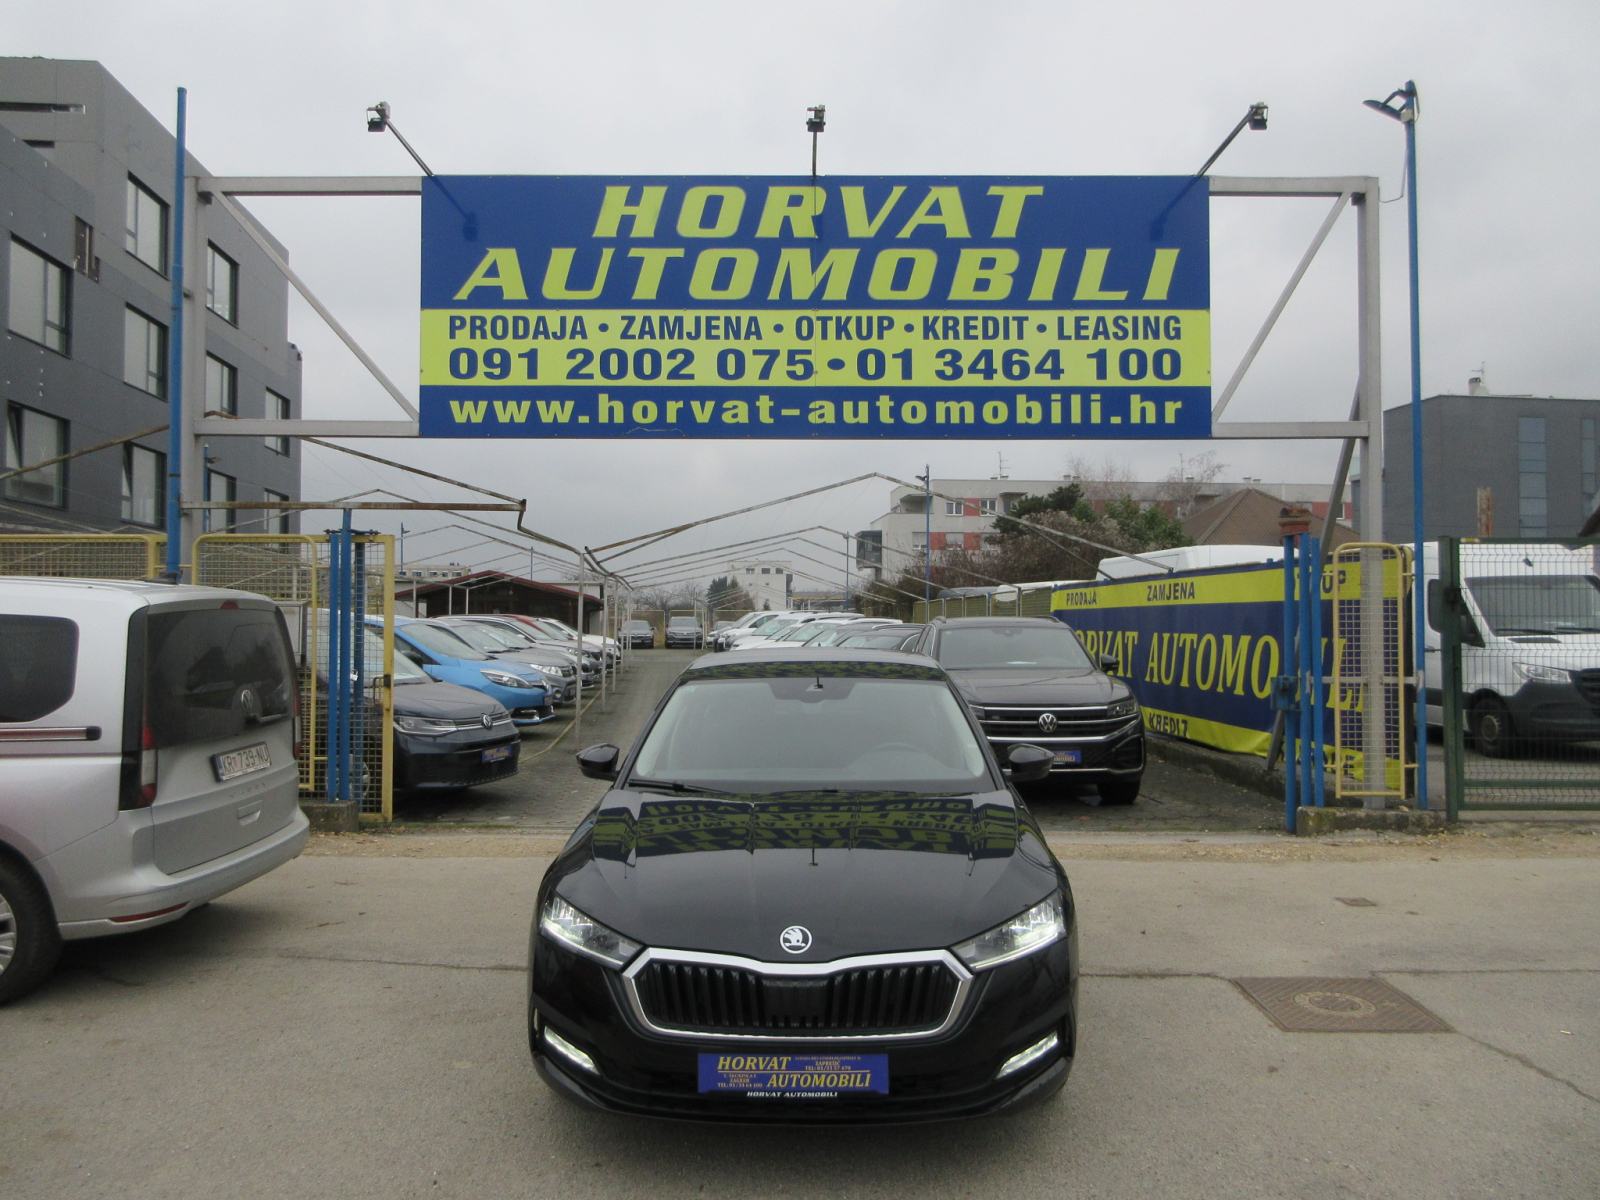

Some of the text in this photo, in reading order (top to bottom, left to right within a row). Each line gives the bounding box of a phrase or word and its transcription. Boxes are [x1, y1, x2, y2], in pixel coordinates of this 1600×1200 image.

[592, 185, 1044, 238] HORVAT
[452, 247, 1181, 301] AUTOMOBILI
[448, 314, 1182, 341] PRODAJA ZAMJENA OTKUP KREDIT LEASING
[448, 347, 1182, 381] 091 2002 075 01 3464 100
[448, 393, 1182, 424] www.horvat-automobili.hr
[1066, 582, 1196, 606] PRODAJA ZAMJENA
[717, 1056, 791, 1071] HORVAT
[766, 1073, 872, 1088] AUTOMOBILI
